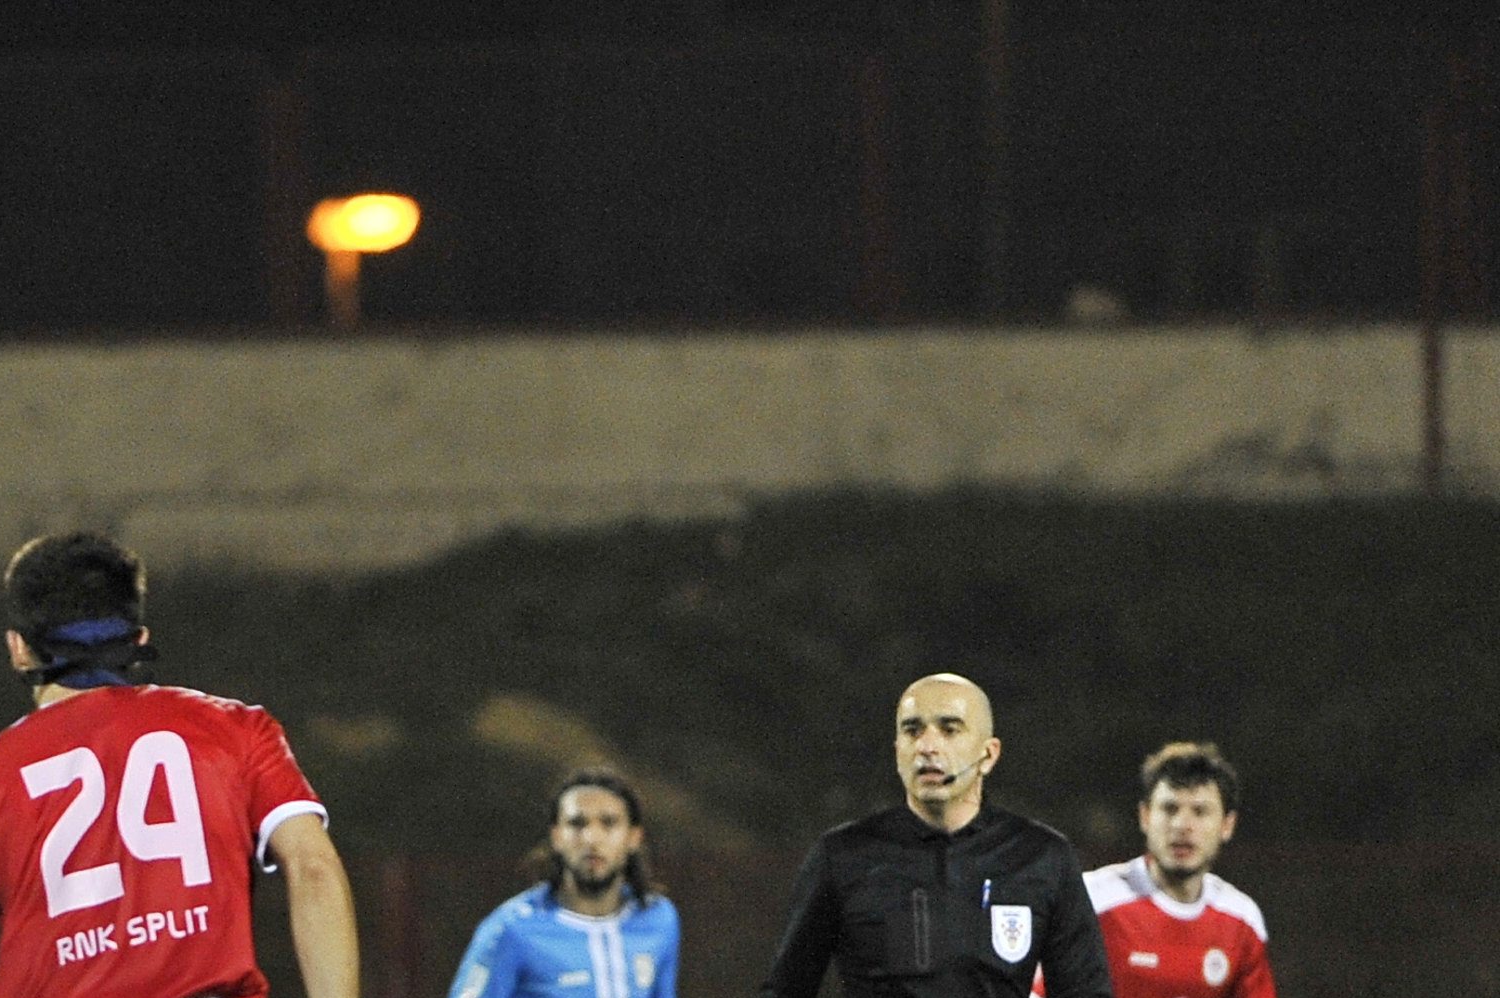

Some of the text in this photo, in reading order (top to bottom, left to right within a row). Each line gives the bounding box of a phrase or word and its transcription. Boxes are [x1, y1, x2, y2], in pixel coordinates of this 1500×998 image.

[19, 730, 212, 918] 24
[56, 905, 209, 966] RNK SPLIT
